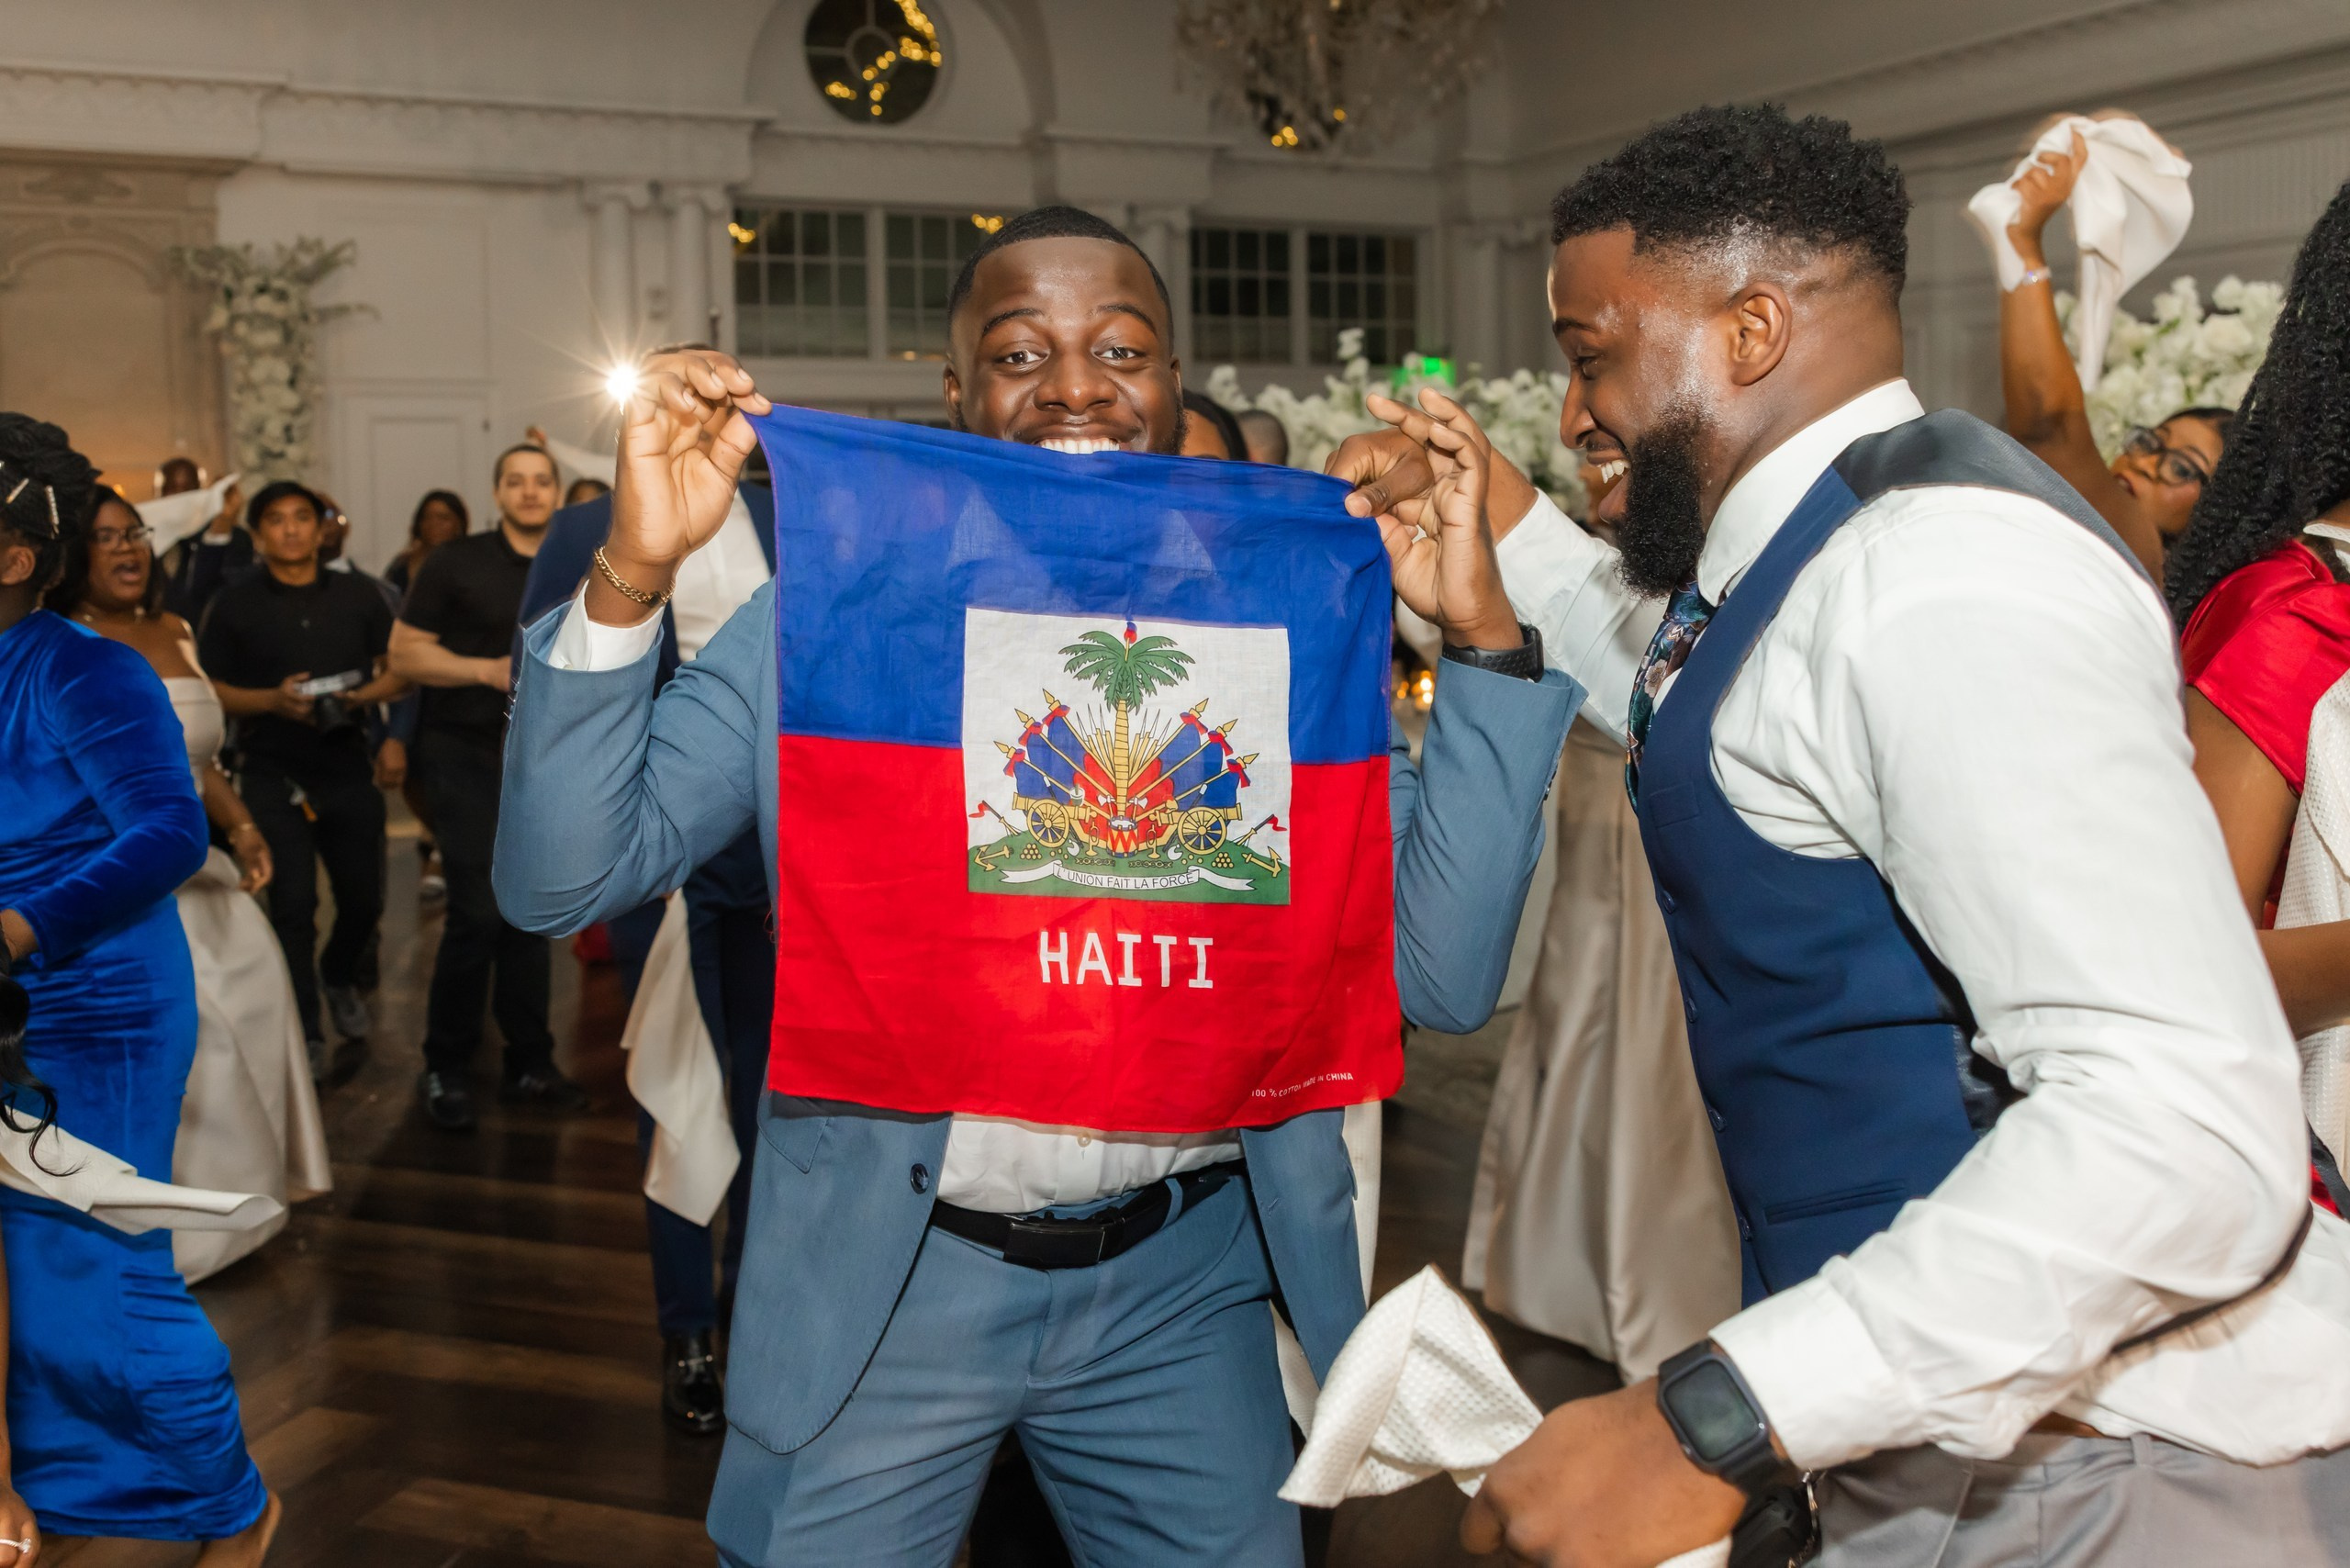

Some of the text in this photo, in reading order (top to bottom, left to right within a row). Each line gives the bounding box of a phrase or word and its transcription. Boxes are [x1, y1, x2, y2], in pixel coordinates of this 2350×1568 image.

[1106, 877, 1131, 889] FAIT
[1134, 877, 1149, 889] LA
[1152, 872, 1194, 888] FORCE
[1039, 931, 1214, 989] HAITI
[1326, 1072, 1354, 1081] CHINA
